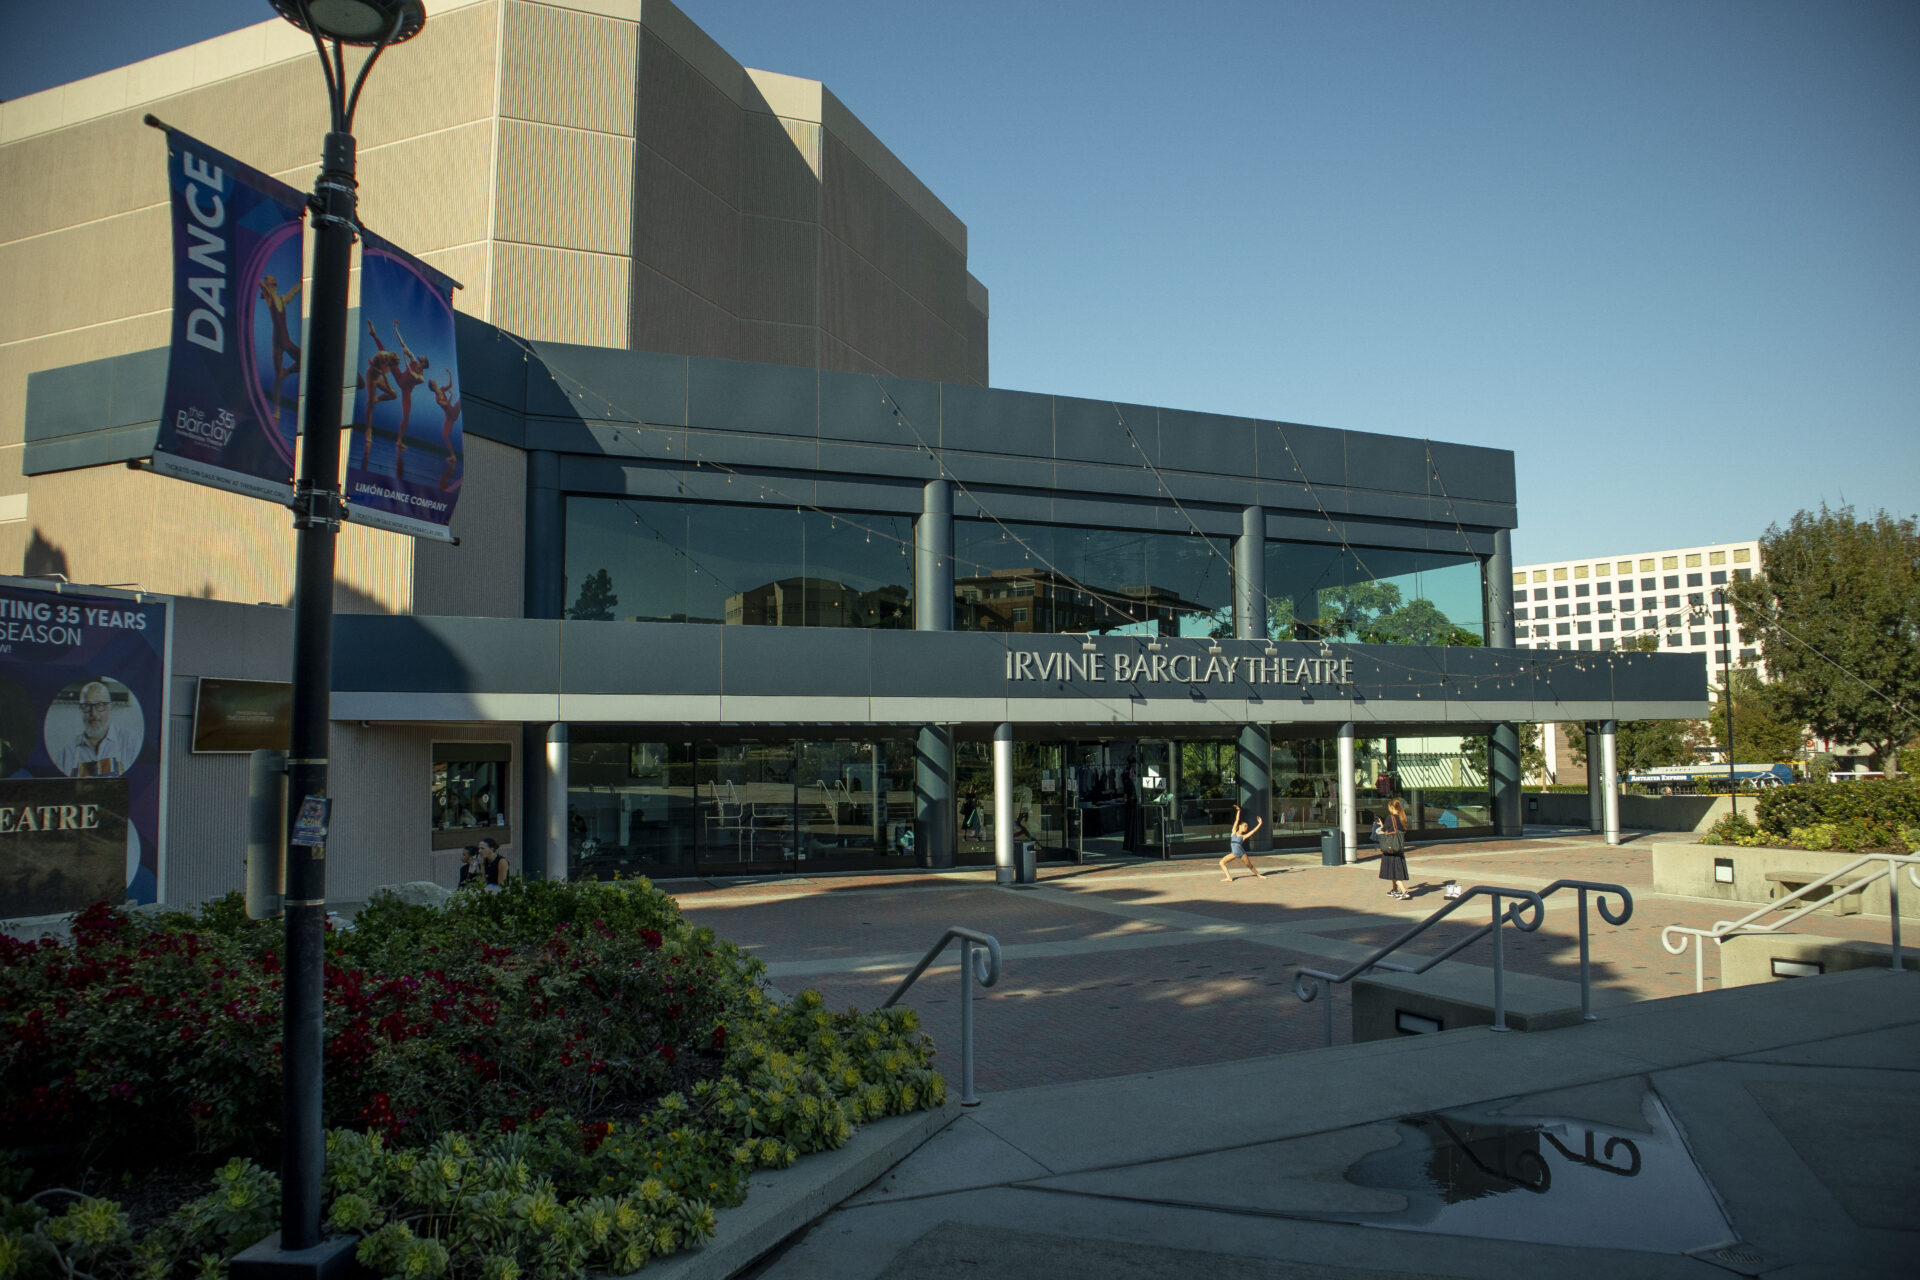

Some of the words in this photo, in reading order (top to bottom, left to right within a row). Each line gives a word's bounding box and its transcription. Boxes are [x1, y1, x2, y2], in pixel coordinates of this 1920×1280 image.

[183, 151, 226, 354] DANCE
[189, 405, 205, 420] the
[216, 407, 234, 429] 35
[176, 409, 232, 446] Barclay
[355, 482, 384, 497] LIMÓN
[384, 489, 410, 503] DANCE
[410, 496, 448, 512] COMPANY
[56, 605, 80, 625] 35
[85, 608, 147, 631] YEARS
[0, 621, 82, 646] SEASON
[1006, 651, 1105, 681] IRVINE
[1115, 653, 1240, 683] BARCLAY
[1243, 657, 1354, 684] THEATRE
[0, 804, 99, 833] EATRE
